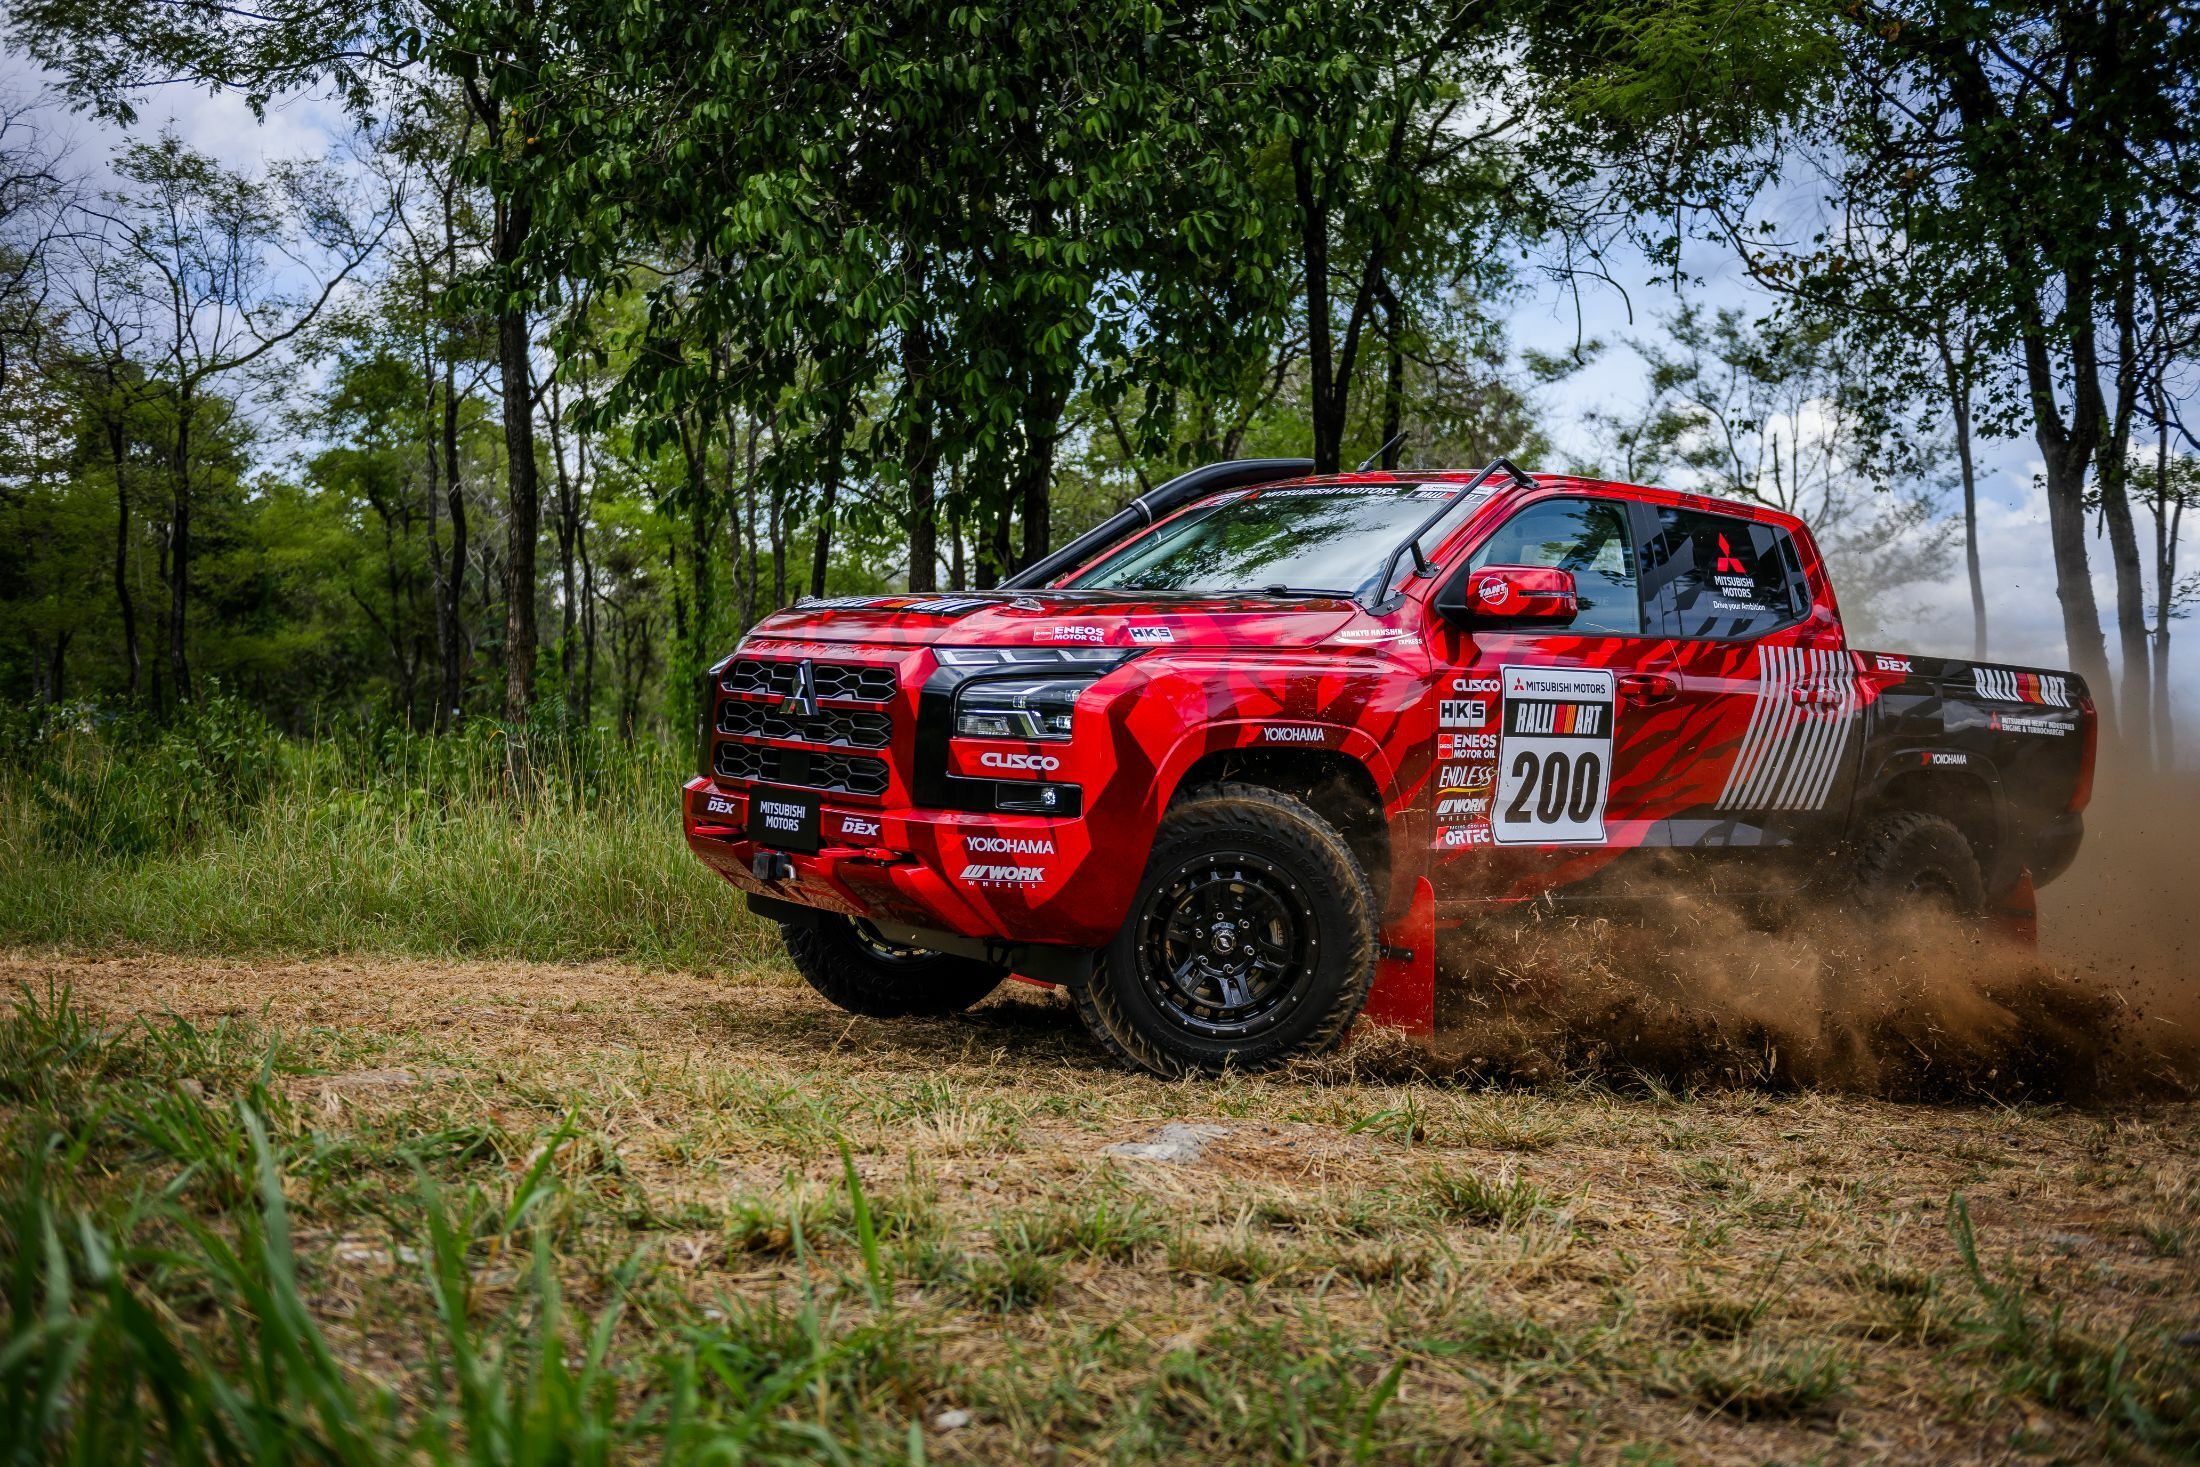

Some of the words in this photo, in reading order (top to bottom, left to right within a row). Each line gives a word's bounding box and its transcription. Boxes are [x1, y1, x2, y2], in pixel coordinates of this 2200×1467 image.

[1259, 488, 1339, 498] MITSUBISHI
[1337, 487, 1402, 495] MOTORS
[1714, 575, 1754, 588] MITSUBISHI
[1722, 586, 1752, 598] MOTORS
[1712, 600, 1728, 609] Drive
[1728, 603, 1740, 611] your
[1741, 602, 1766, 611] Ambition
[1054, 626, 1105, 636] ENEOS
[1130, 628, 1171, 638] HKS
[1877, 659, 1914, 673] DEX
[1452, 678, 1501, 692] CUSCO
[1526, 680, 1572, 693] MITSUBISHI
[1573, 682, 1606, 694] MOTORS
[1441, 702, 1484, 719] HKS
[1263, 726, 1325, 742] YOKOHAMA
[1454, 733, 1497, 748] ENEOS
[981, 752, 1060, 771] CUSCO
[1454, 749, 1482, 759] MOTOR
[1483, 749, 1496, 759] OIL
[1932, 753, 1967, 765] YOKOHAMA
[1438, 766, 1494, 788] ENDLESS
[1504, 750, 1601, 824] 200
[707, 800, 736, 815] DEX
[760, 801, 806, 819] MITSUBISHI
[1451, 798, 1491, 813] WORK
[765, 815, 799, 832] MOTORS
[841, 821, 881, 836] DEX
[967, 836, 1055, 855] YOKOHAMA
[987, 865, 1046, 881] WORK
[968, 880, 1037, 889] WHEELS
